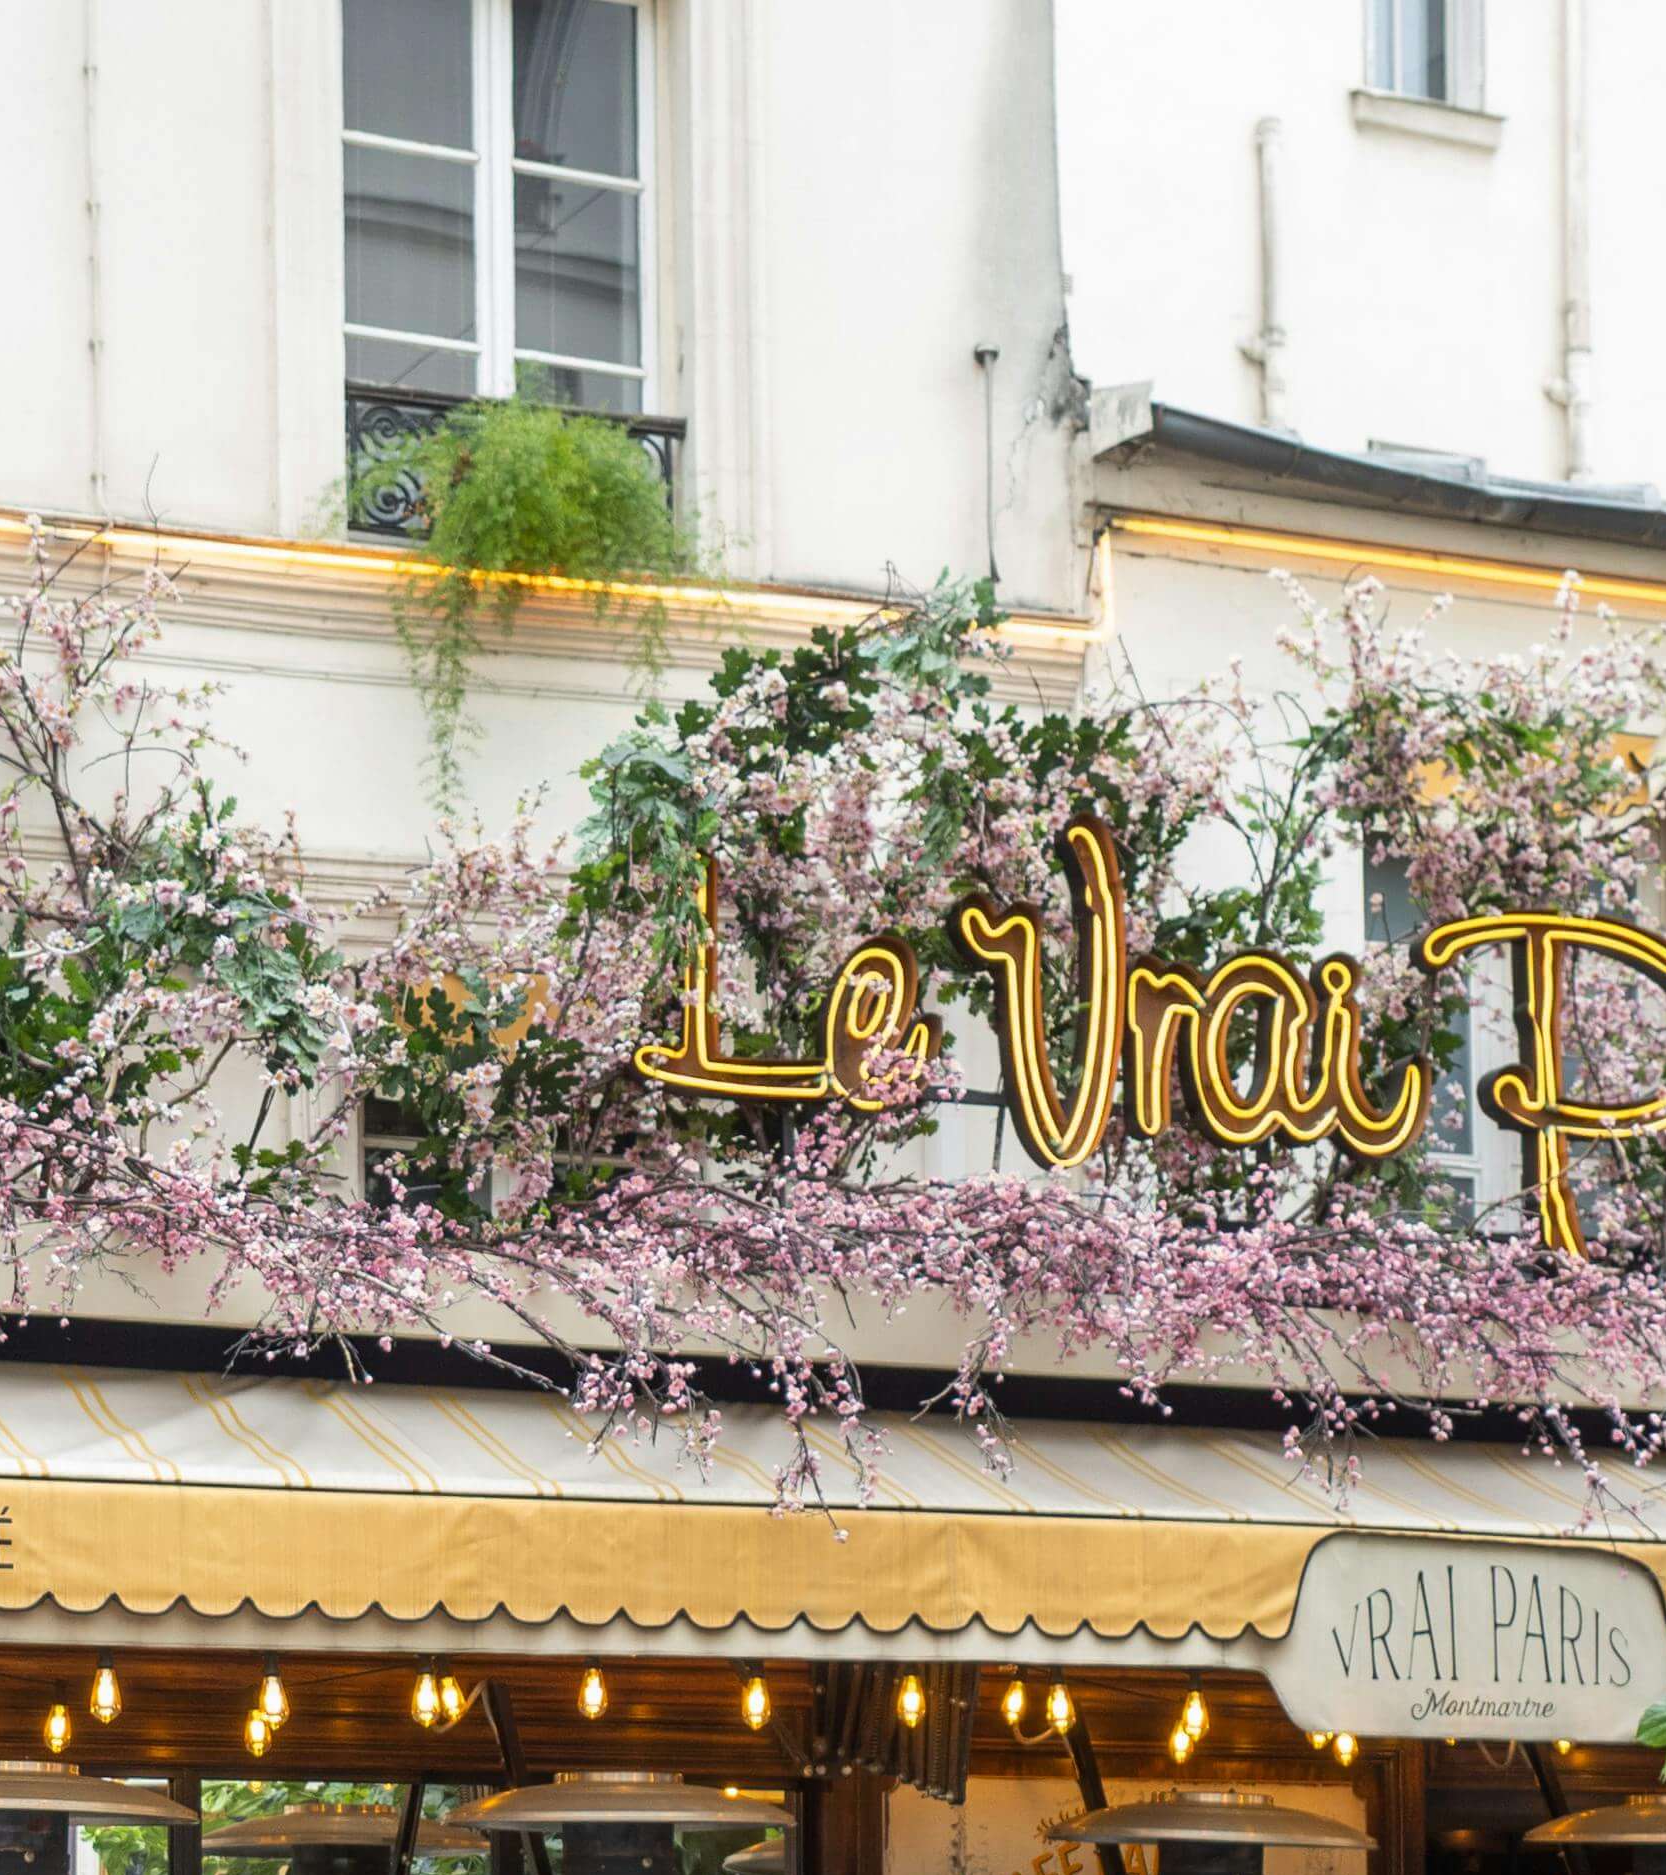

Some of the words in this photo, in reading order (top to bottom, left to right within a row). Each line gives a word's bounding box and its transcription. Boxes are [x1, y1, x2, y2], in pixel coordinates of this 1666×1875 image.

[634, 852, 943, 1114] Le
[953, 812, 1429, 1170] Vrai
[1331, 1564, 1459, 1680] VRAI
[1490, 1565, 1632, 1688] PARIS
[1411, 1687, 1557, 1720] Montmartre
